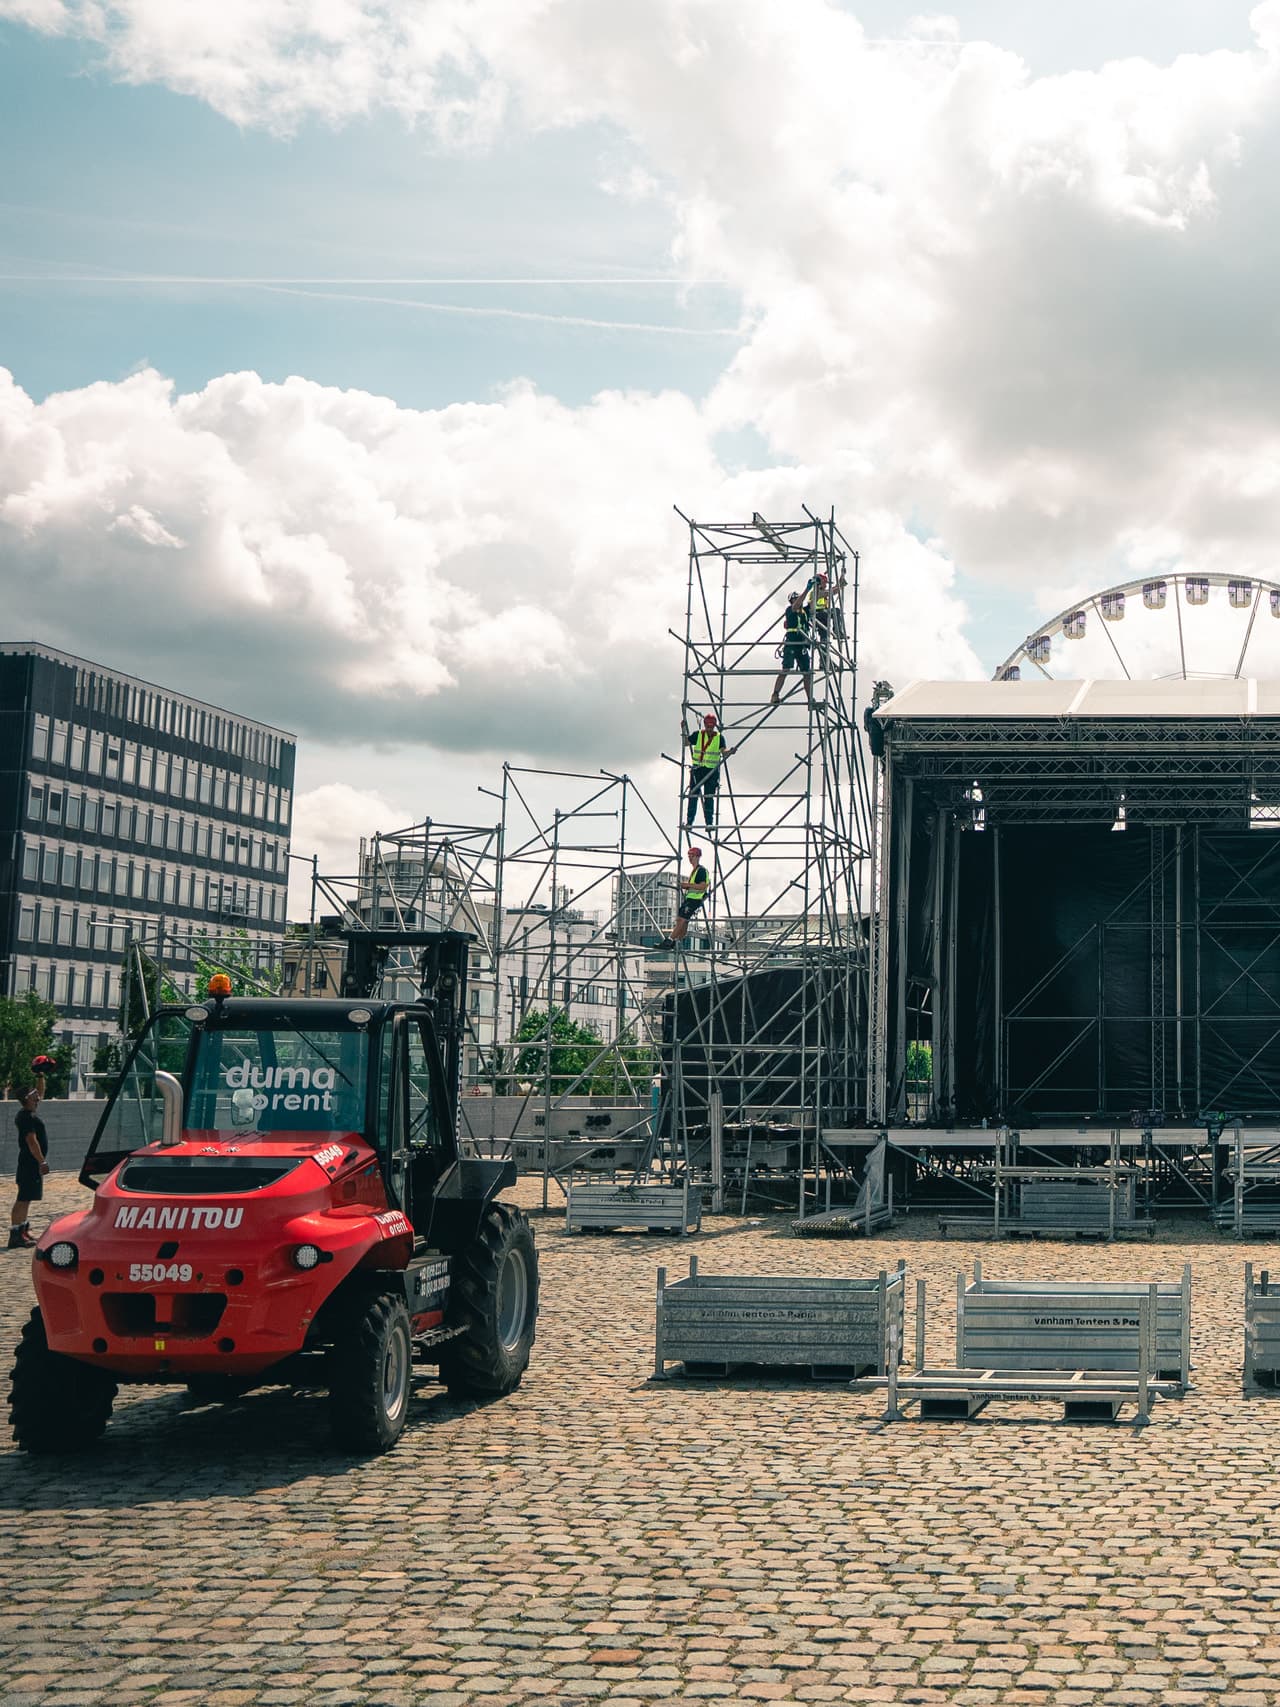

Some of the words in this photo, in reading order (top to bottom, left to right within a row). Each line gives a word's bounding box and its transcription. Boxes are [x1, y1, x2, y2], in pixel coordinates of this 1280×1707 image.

[225, 1059, 336, 1089] duma
[271, 1090, 333, 1111] rent
[313, 1144, 344, 1166] 55049
[114, 1206, 244, 1230] MANITOU
[129, 1263, 193, 1282] 55049
[1075, 1318, 1110, 1326] Tenten
[1112, 1318, 1120, 1326] &
